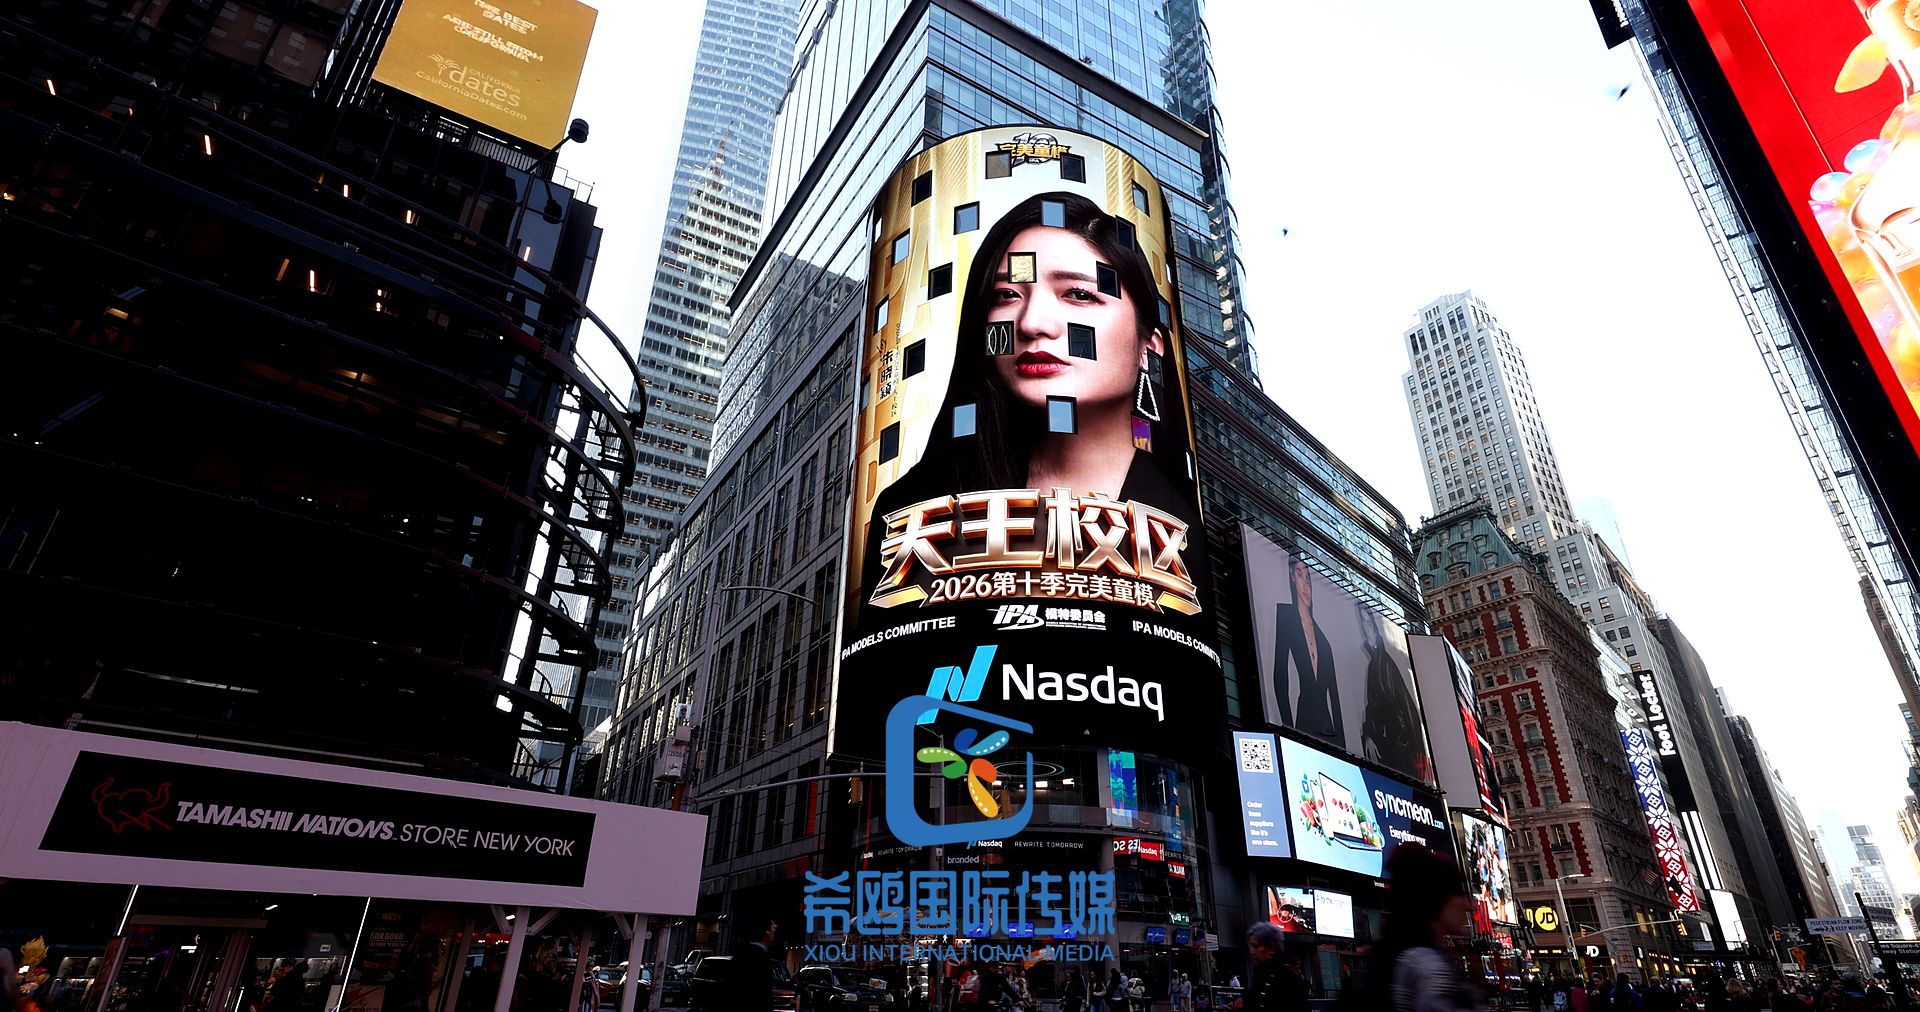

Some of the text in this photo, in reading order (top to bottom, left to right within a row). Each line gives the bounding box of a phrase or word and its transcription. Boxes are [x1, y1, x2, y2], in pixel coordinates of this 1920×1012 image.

[482, 10, 527, 35] DATES
[503, 12, 538, 31] BEST
[454, 25, 529, 63] CALIFORNIA
[416, 71, 527, 120] CaliforniaDates.com
[449, 66, 520, 107] dates
[870, 487, 1200, 604] 天王校区
[930, 571, 1156, 608] 2026第十季完美童模
[851, 633, 883, 654] MODELS
[884, 616, 955, 640] COMMITTEE
[1132, 620, 1152, 635] IPA
[1153, 625, 1192, 647] MODELS
[1002, 664, 1165, 721] Nasdaq
[1639, 674, 1676, 755] Foot Locker
[176, 801, 576, 857] TAMASHII NATIONS STORE NEW YORK
[978, 840, 1002, 848] Nasdaq
[947, 855, 979, 864] branded
